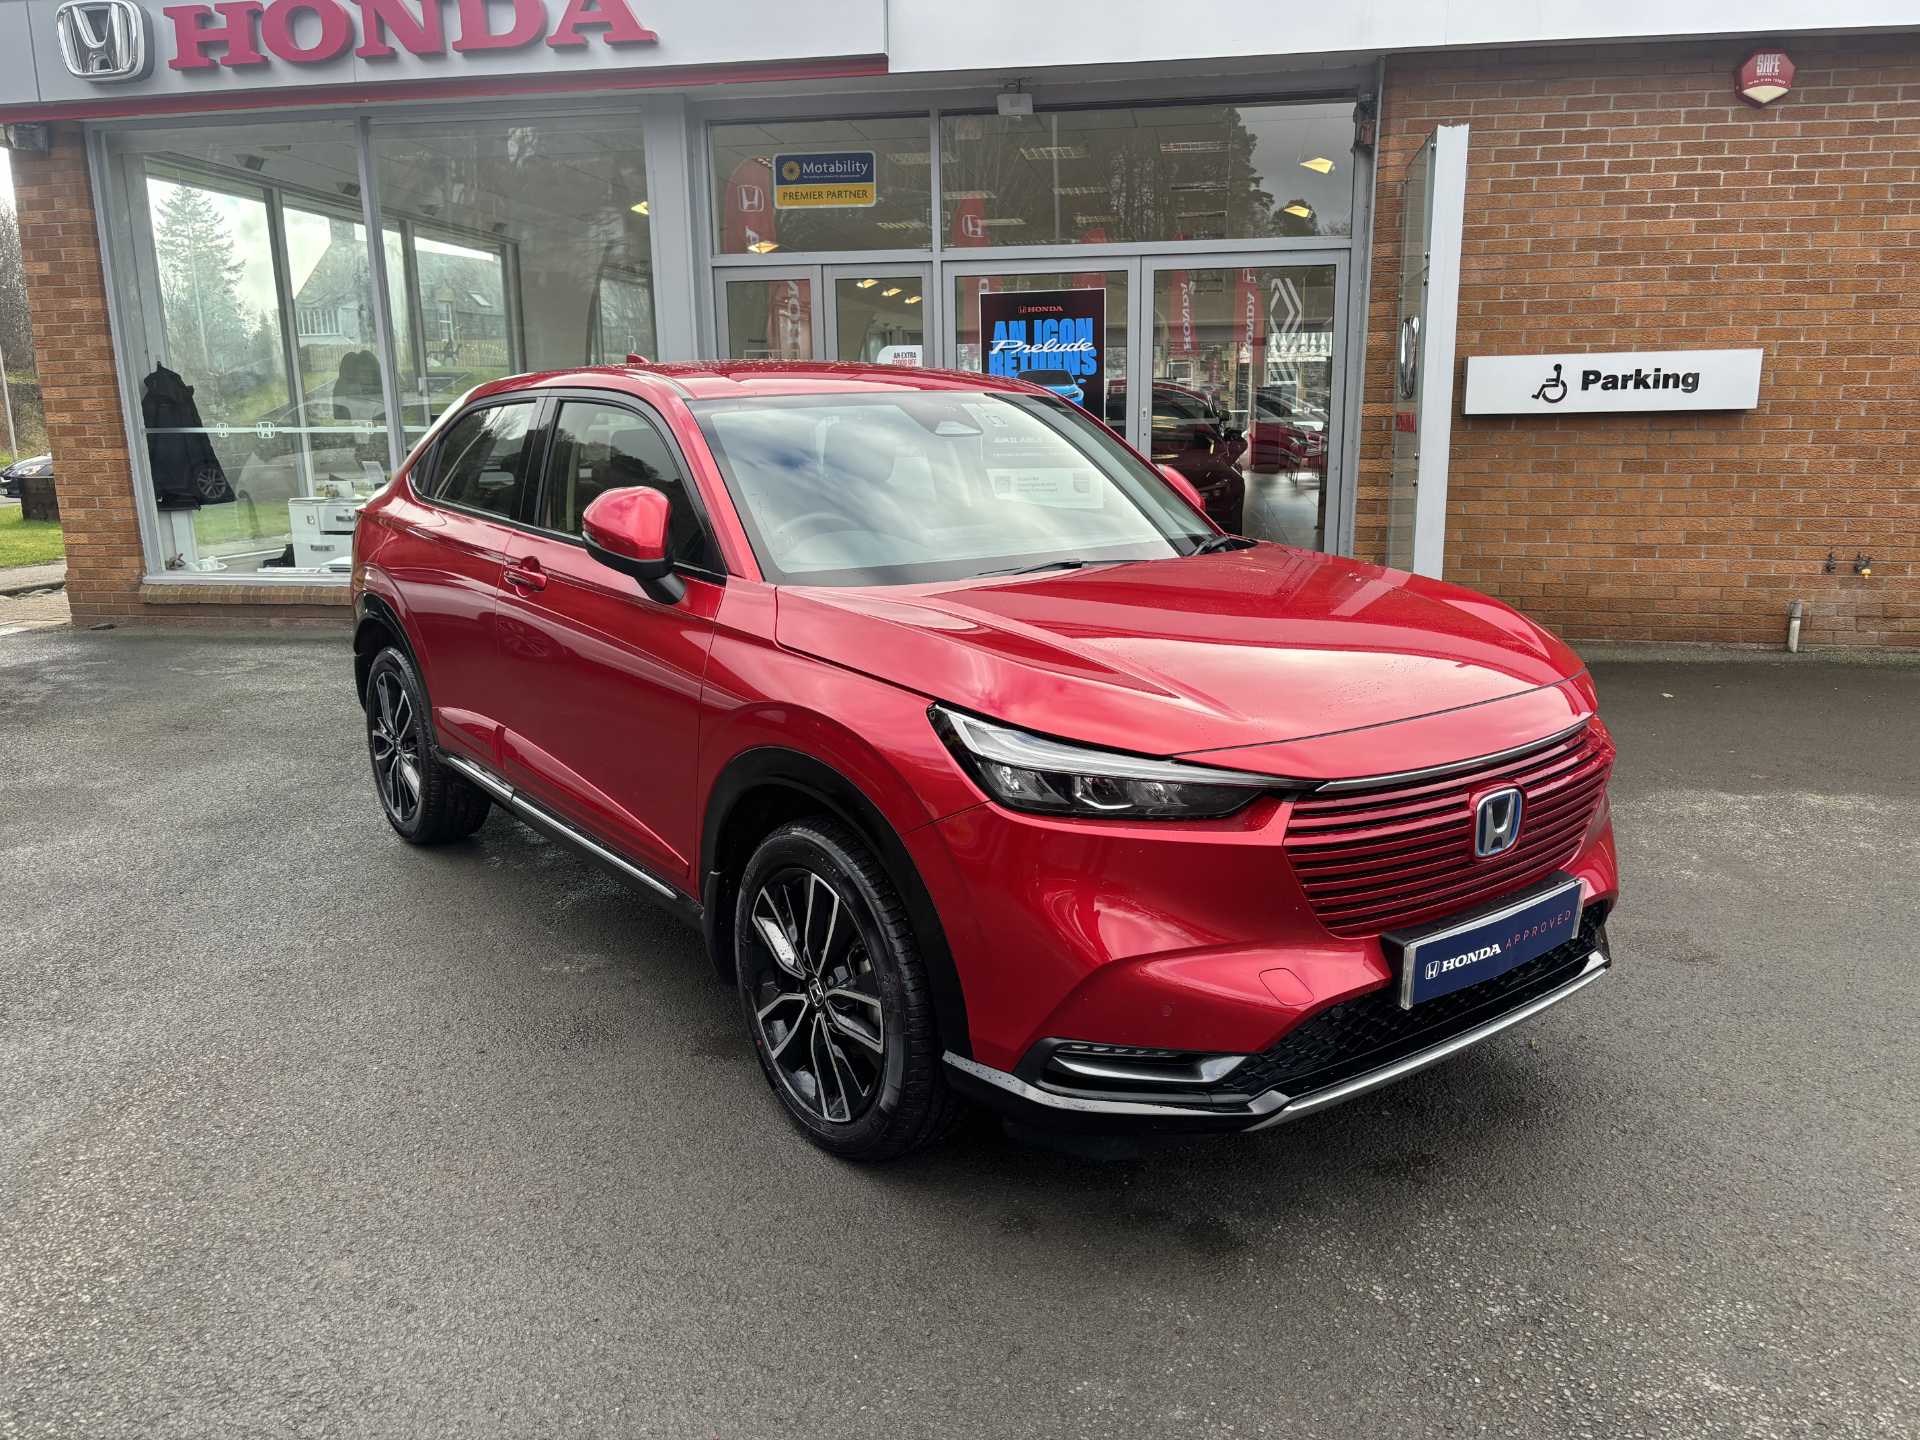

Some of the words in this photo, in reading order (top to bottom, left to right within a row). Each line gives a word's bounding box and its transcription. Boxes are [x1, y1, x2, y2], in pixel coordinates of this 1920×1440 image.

[163, 0, 659, 71] HONDA
[1756, 54, 1780, 73] SAFE
[802, 160, 868, 175] Motability
[783, 190, 824, 201] PREMIER
[826, 189, 868, 199] PARTNER
[1027, 305, 1064, 313] HONDA
[992, 319, 1027, 350] AN
[1032, 317, 1094, 349] ICON
[990, 338, 1096, 354] Prelude
[988, 346, 1098, 378] RETURNS
[1581, 368, 1700, 393] Parking
[1441, 943, 1501, 973] HONDA
[1505, 910, 1571, 950] APPROVED
